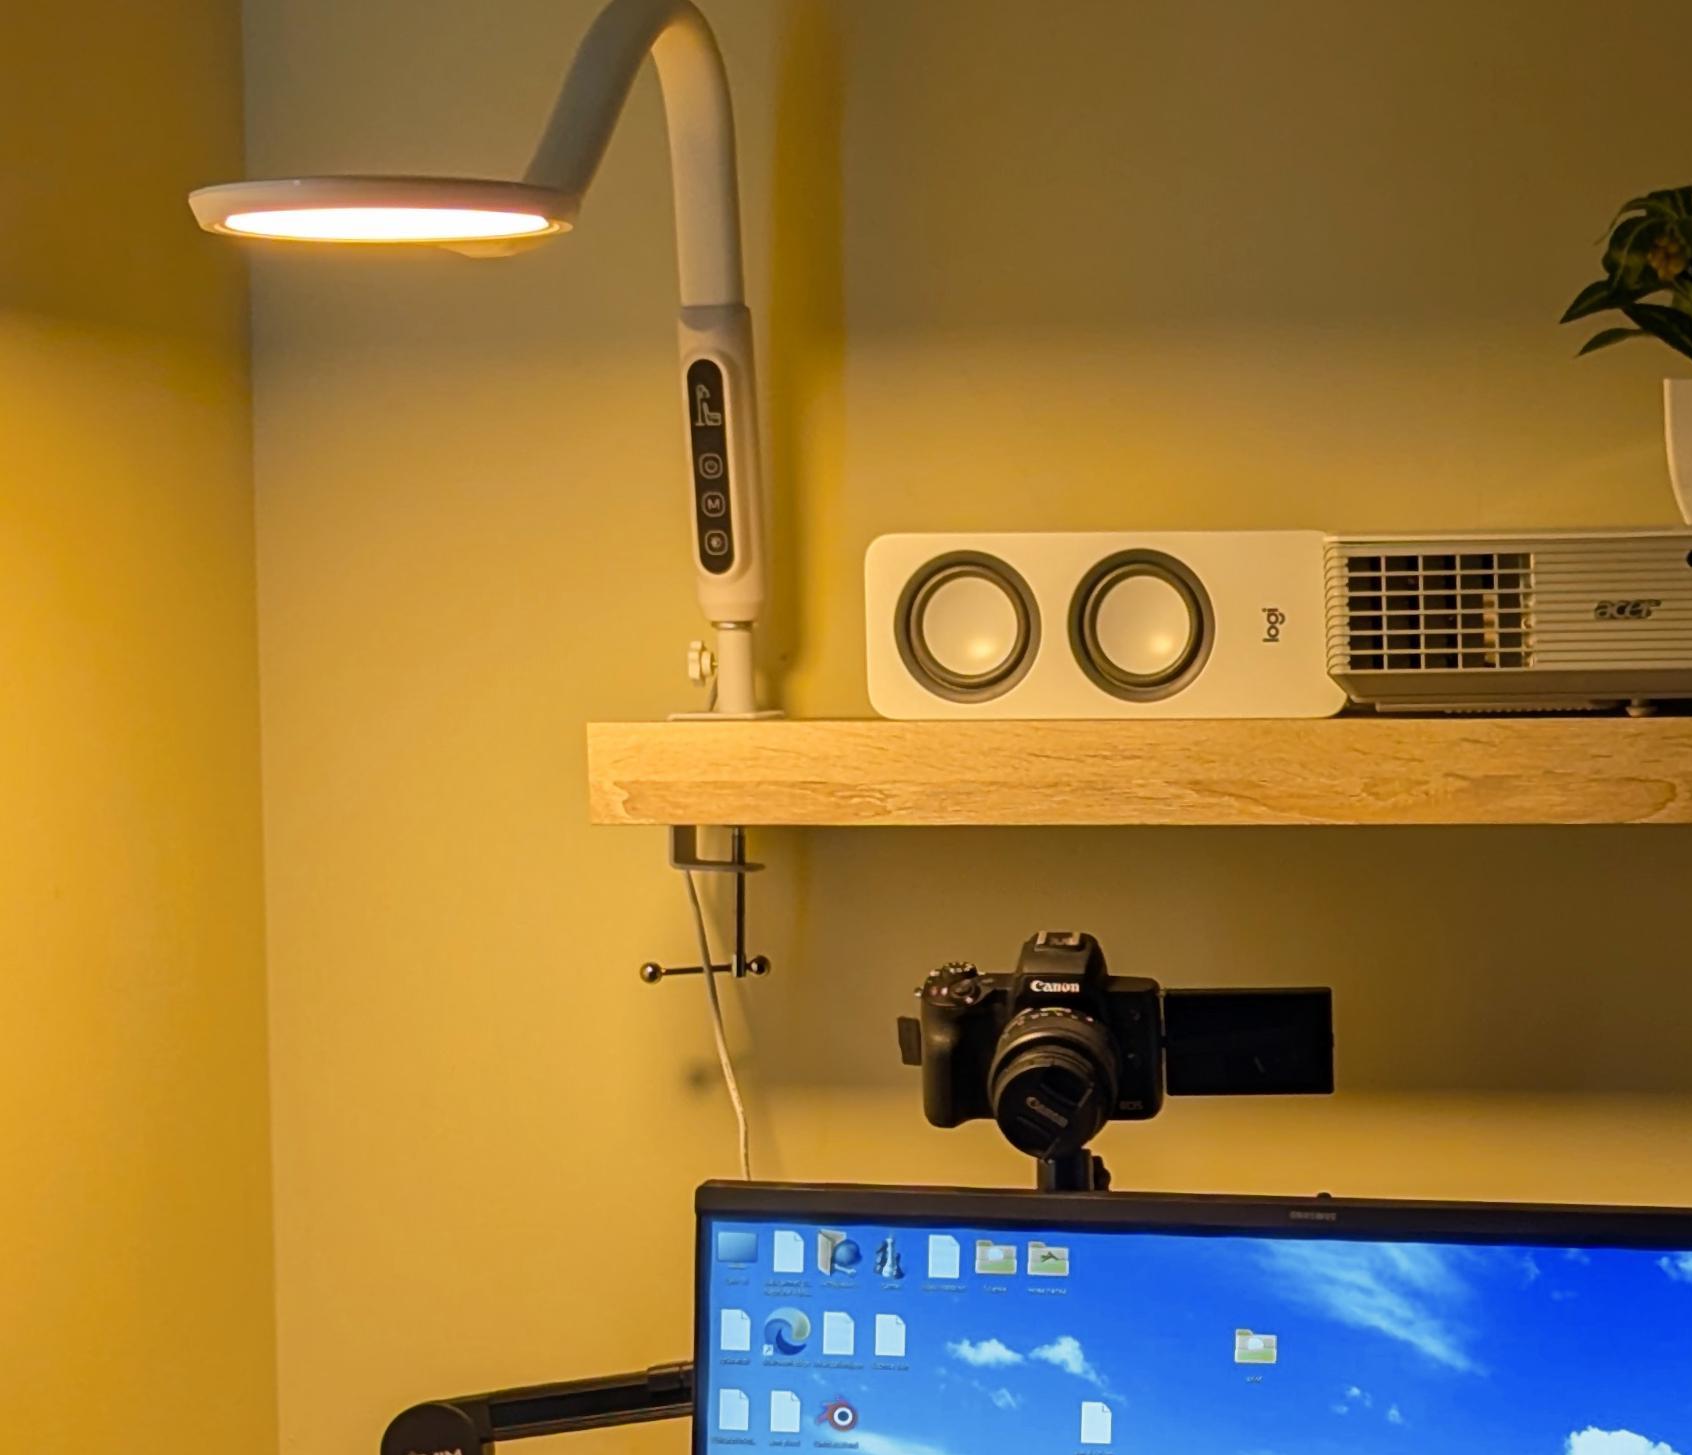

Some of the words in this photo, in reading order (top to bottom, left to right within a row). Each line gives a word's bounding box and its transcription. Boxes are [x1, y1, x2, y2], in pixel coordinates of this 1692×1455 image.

[1595, 599, 1661, 620] acer
[1262, 608, 1286, 643] logi
[1030, 980, 1080, 993] Canon
